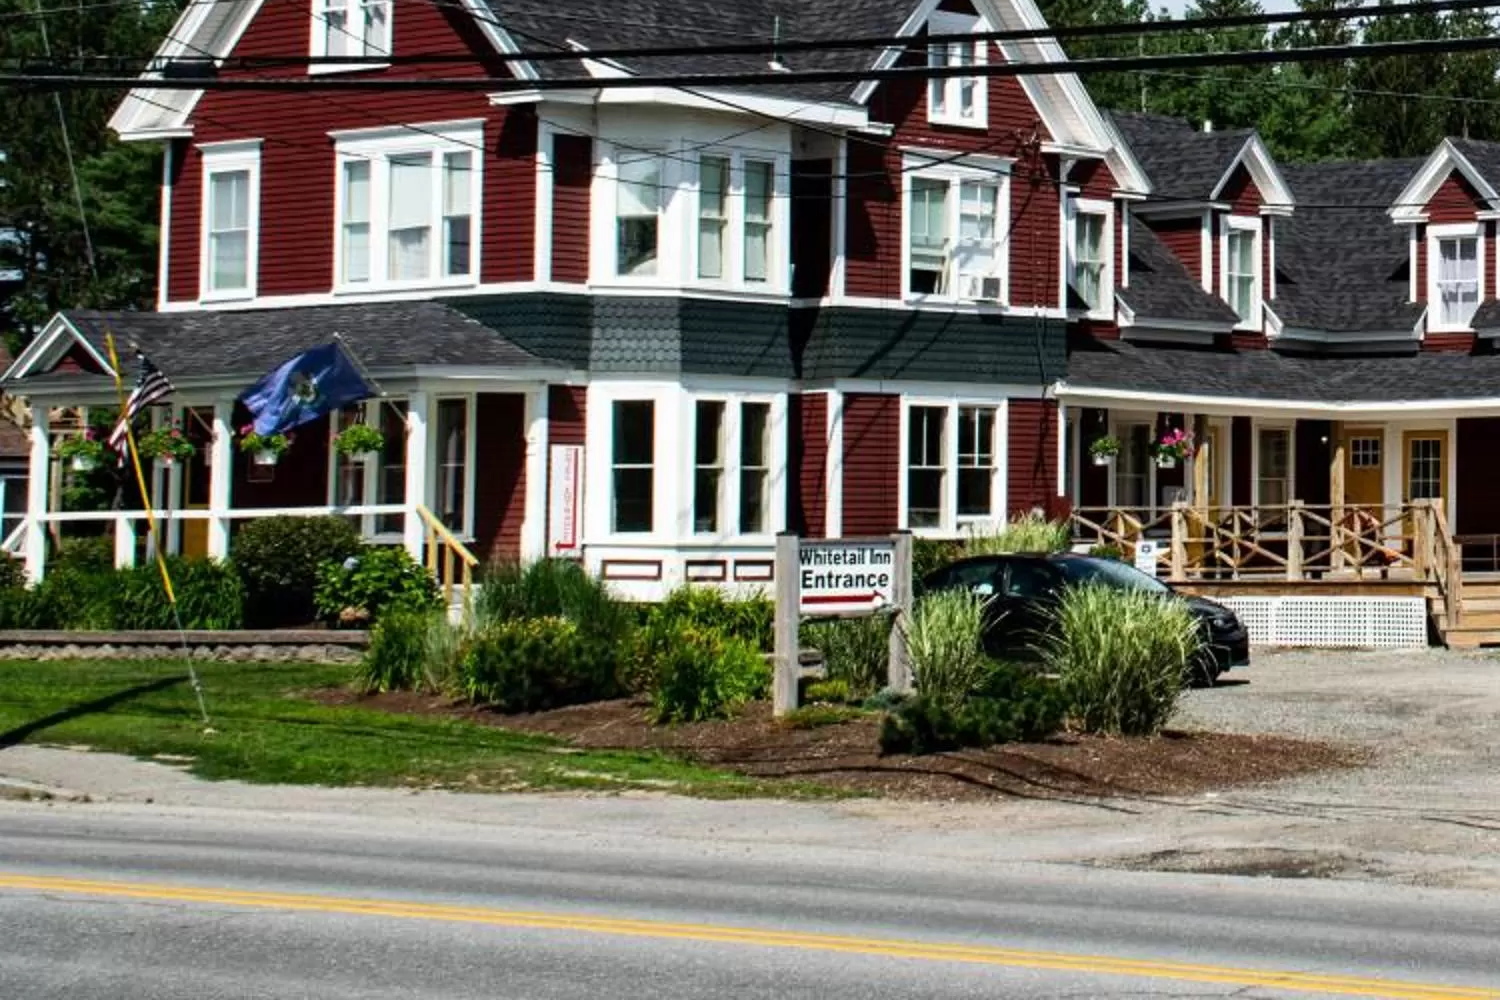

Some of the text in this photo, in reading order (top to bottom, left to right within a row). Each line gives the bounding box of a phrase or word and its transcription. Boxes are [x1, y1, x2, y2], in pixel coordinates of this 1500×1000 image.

[800, 548, 891, 566] Whitetail Inn
[801, 570, 889, 589] Entrance
